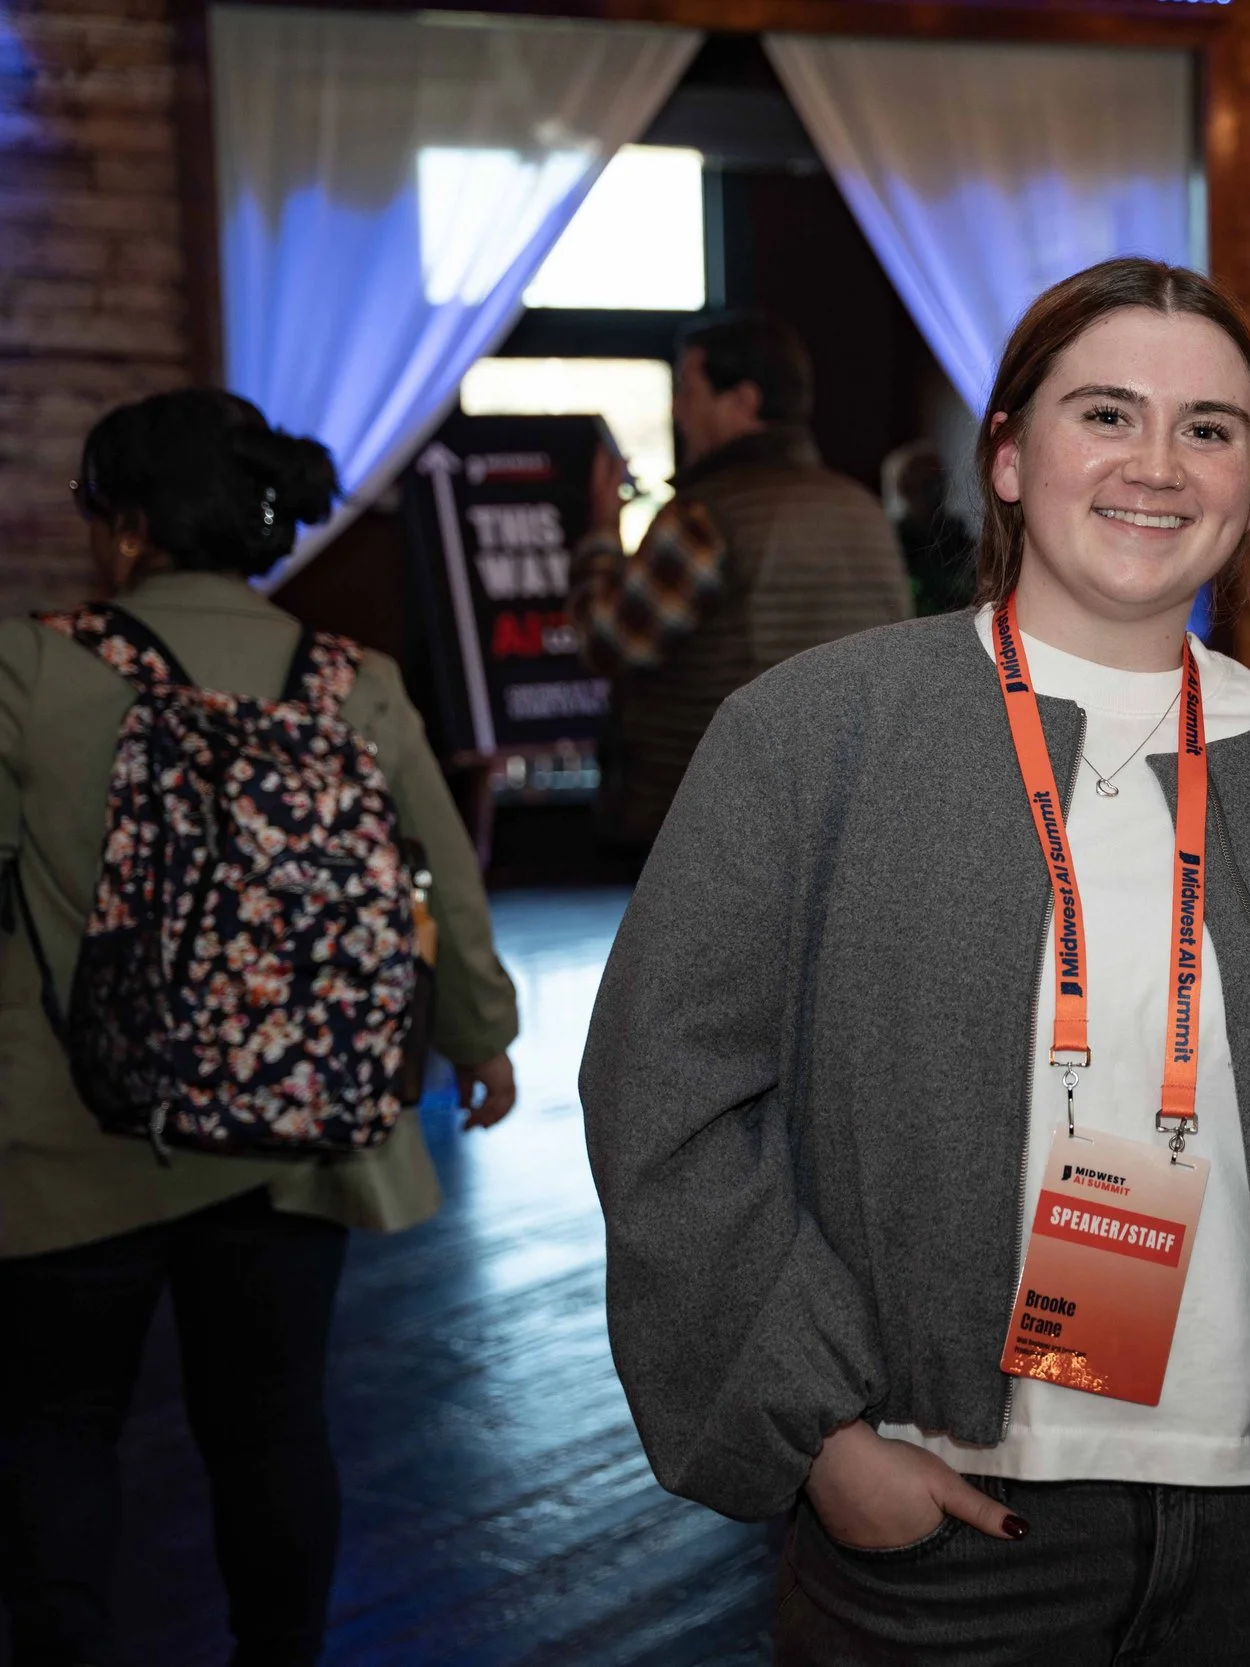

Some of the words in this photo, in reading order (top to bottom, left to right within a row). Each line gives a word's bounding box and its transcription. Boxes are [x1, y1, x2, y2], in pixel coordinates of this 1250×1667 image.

[467, 504, 564, 548] THIS
[995, 610, 1022, 680] Midwest
[1187, 671, 1198, 693] AI
[1186, 691, 1203, 756] Summit
[1033, 791, 1066, 863] Summit
[1054, 865, 1071, 885] AI
[1181, 867, 1201, 946] Midwest
[1059, 887, 1079, 978] Midwest
[1178, 948, 1196, 972] AI
[1174, 973, 1196, 1063] Summit
[1073, 1175, 1085, 1185] AI
[1087, 1178, 1131, 1196] SUMMIT
[1075, 1166, 1126, 1186] MIDWEST
[1050, 1205, 1175, 1253] SPEAKER/STAFF
[1020, 1312, 1062, 1338] Crane
[1025, 1289, 1076, 1317] Brooke
